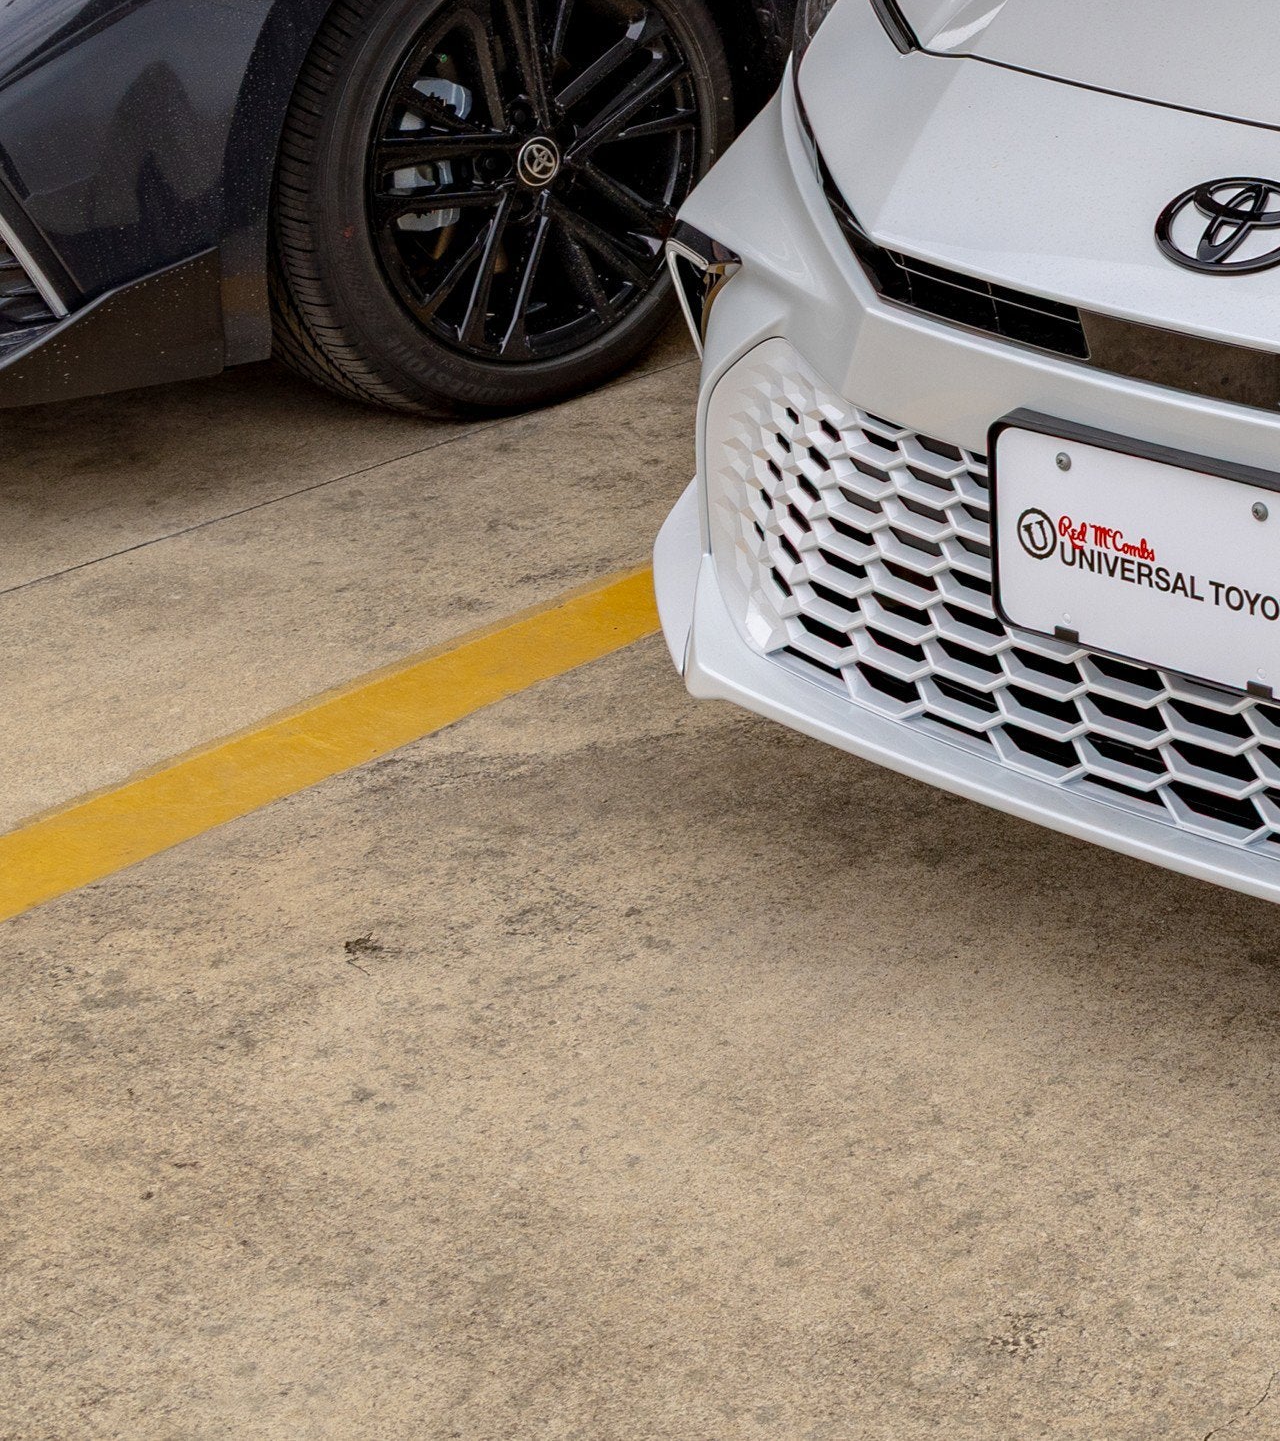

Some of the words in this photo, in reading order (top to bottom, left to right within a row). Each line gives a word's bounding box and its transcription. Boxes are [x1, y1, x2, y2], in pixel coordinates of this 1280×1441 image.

[1058, 515, 1088, 550] Red
[1090, 523, 1155, 562] McCombs
[1060, 541, 1205, 601] UNIVERSAL
